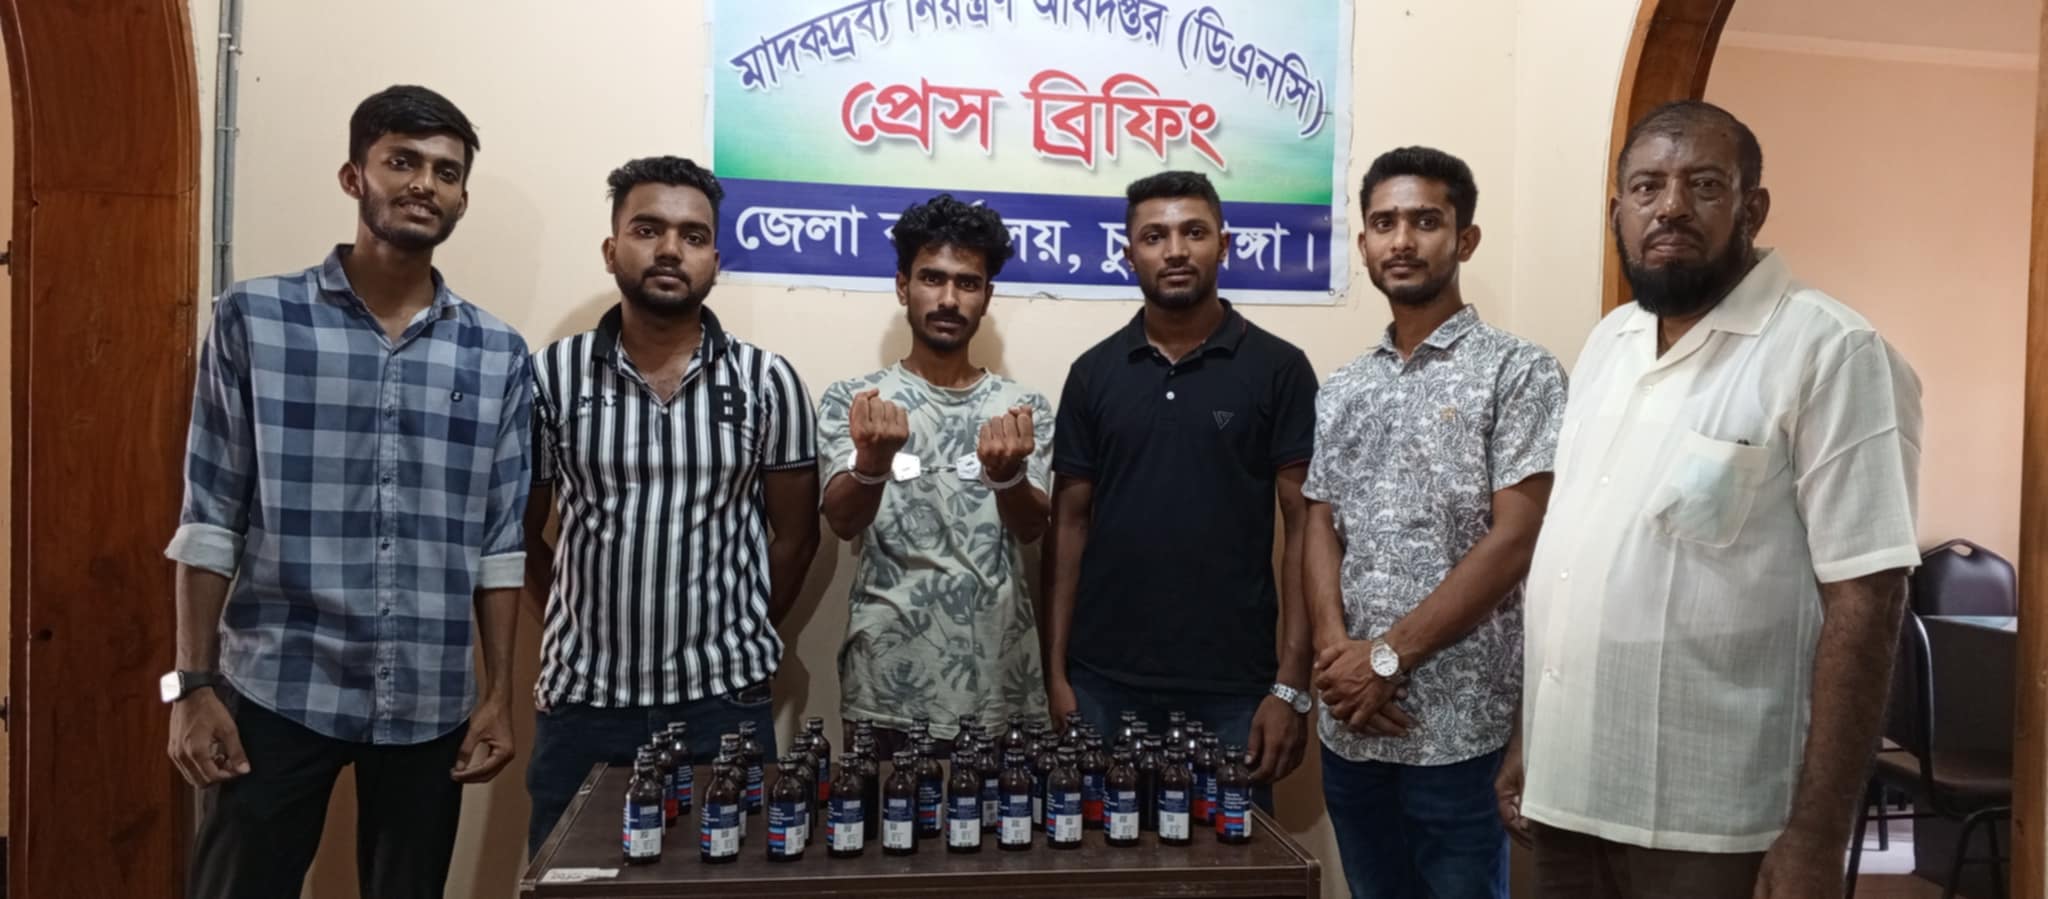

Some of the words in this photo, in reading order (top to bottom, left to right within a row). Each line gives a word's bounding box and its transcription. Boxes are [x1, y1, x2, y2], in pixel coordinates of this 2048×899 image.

[730, 0, 889, 88] মাদকদ্রব্য
[1177, 6, 1324, 136] (ডিএনসি)
[841, 76, 1004, 152] প্রেস
[1019, 69, 1225, 168] ব্রিফিং
[735, 204, 868, 257] জেলা
